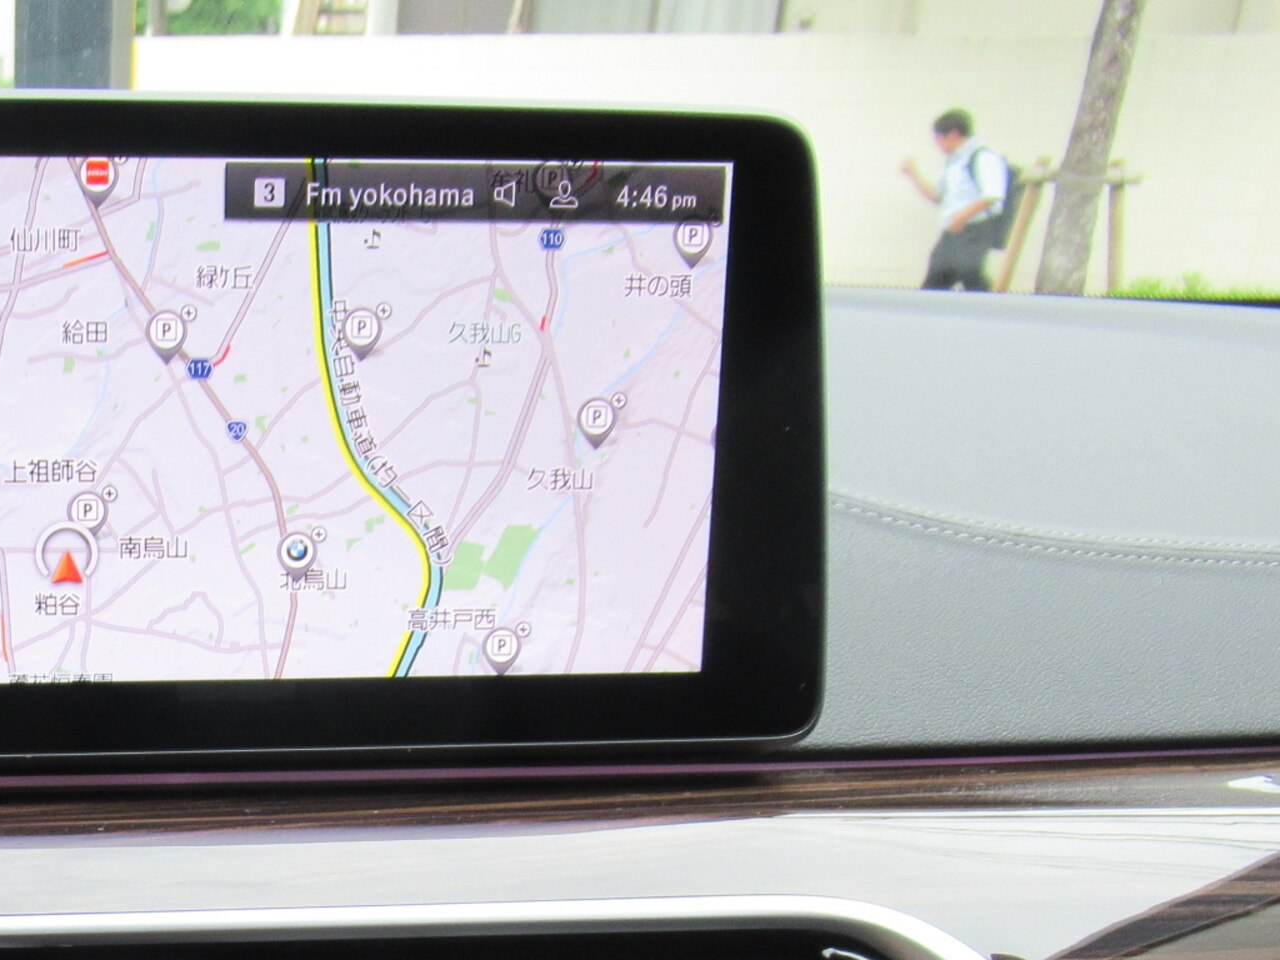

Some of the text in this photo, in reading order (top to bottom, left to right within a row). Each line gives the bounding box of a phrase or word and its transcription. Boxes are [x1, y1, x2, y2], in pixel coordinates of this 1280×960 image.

[264, 182, 276, 202] 3
[306, 182, 474, 210] Fm yokohama
[616, 185, 697, 211] 4:46 pm
[10, 228, 81, 253] 仙川町
[541, 232, 562, 246] 110
[624, 274, 692, 298] 井の頭
[62, 321, 107, 345] 給田
[448, 322, 521, 345] 久我山G
[188, 363, 211, 376] 117
[228, 423, 246, 437] 20
[4, 459, 97, 484] 上祖師谷
[527, 467, 593, 491] 久我山
[35, 593, 80, 616] 粕谷
[407, 608, 496, 631] 高井戸西
